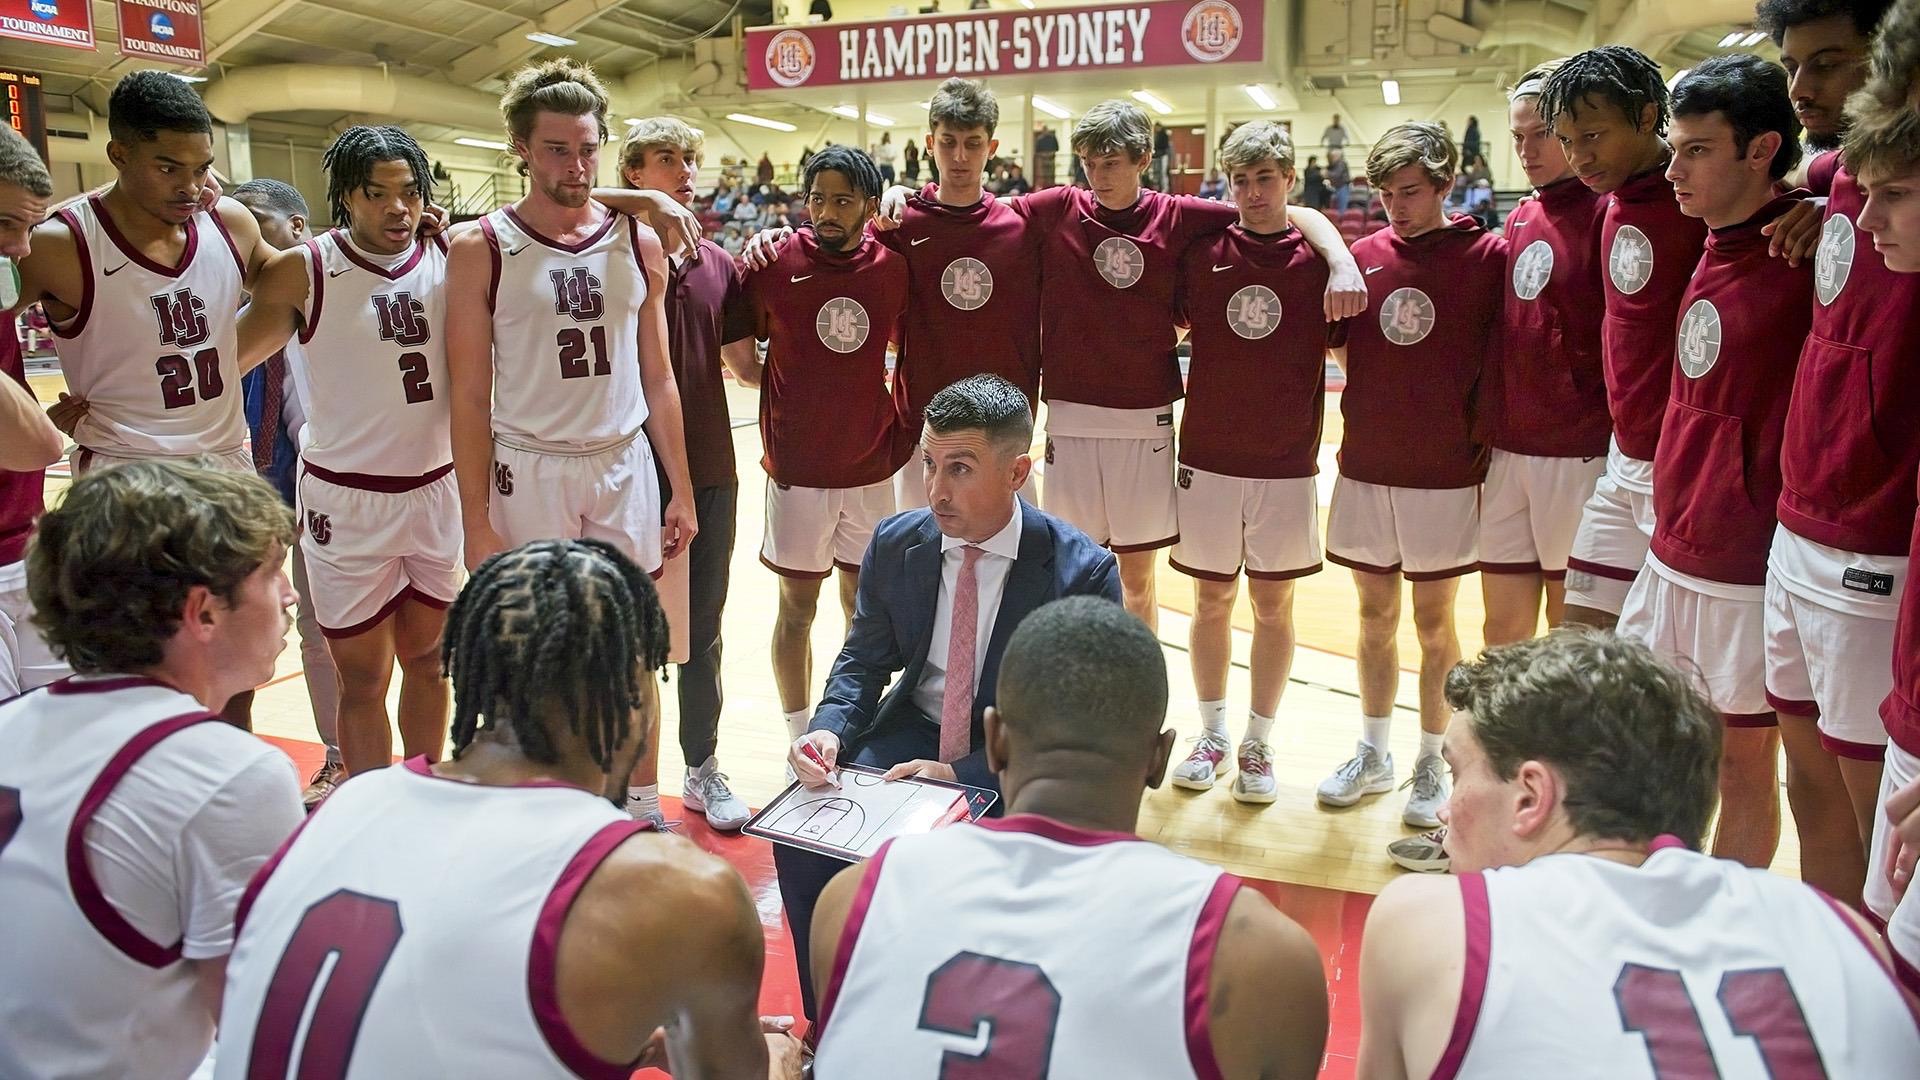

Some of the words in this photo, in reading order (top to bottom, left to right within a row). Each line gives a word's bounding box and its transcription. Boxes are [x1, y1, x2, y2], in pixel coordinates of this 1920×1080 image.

[31, 2, 58, 16] NCAA
[0, 16, 89, 42] TOURNAMENT
[124, 37, 201, 60] TOURNAMENT
[151, 23, 175, 37] NCAA
[839, 8, 1151, 80] HAMPDEN-SYDNEY
[556, 325, 612, 379] 21
[155, 346, 224, 410] 20
[398, 351, 434, 404] 2
[1873, 579, 1887, 590] XL
[1612, 961, 1832, 1080] 11
